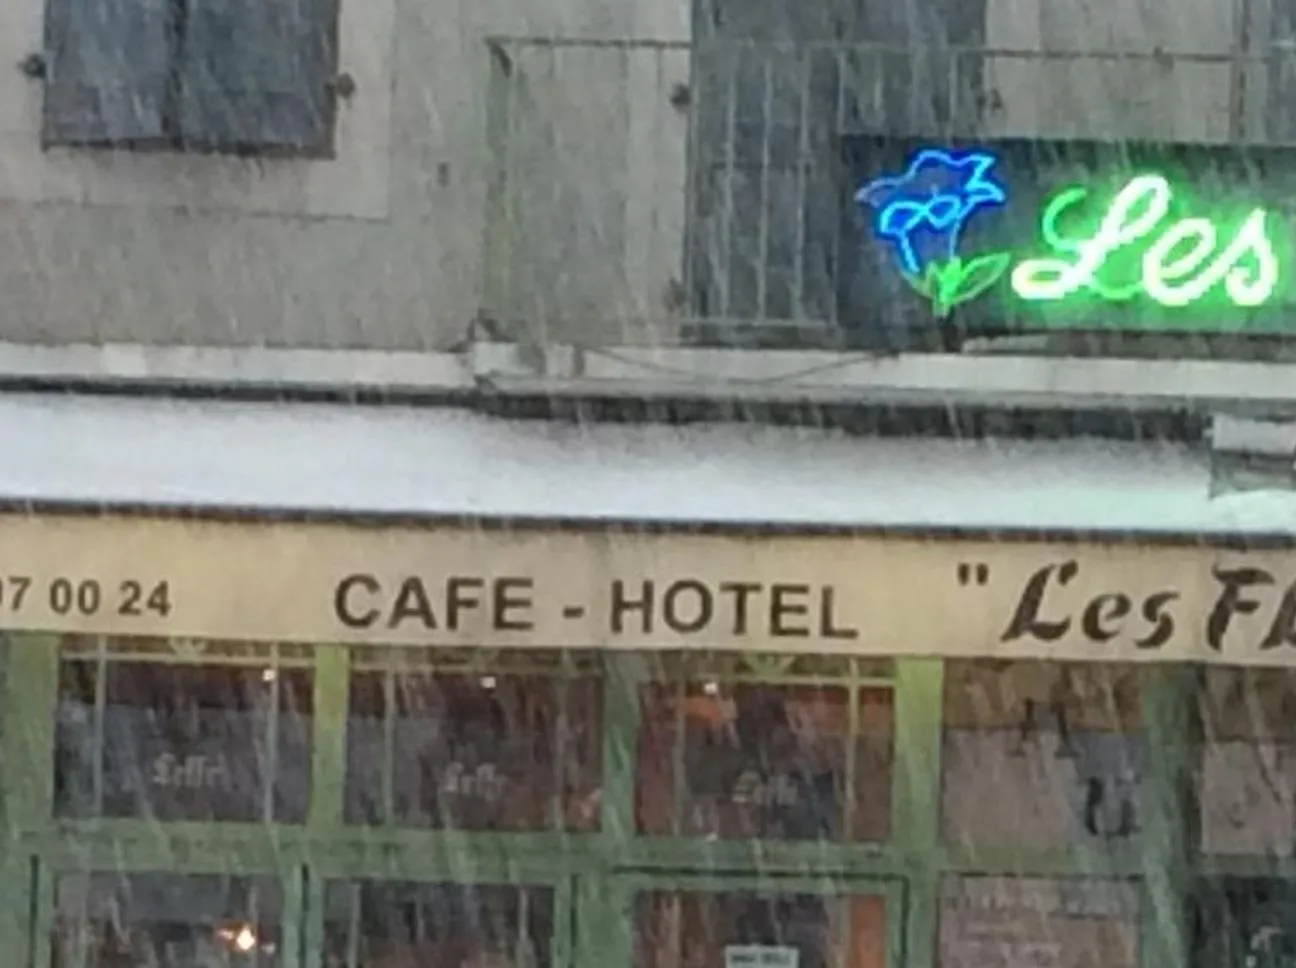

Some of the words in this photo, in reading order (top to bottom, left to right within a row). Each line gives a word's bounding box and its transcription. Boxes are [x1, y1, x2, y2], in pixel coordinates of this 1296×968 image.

[1012, 172, 1279, 305] Les
[0, 575, 32, 611] 7
[50, 577, 100, 615] 00
[118, 580, 172, 617] 24
[334, 573, 534, 631] CAFE
[610, 579, 860, 640] HOTEL
